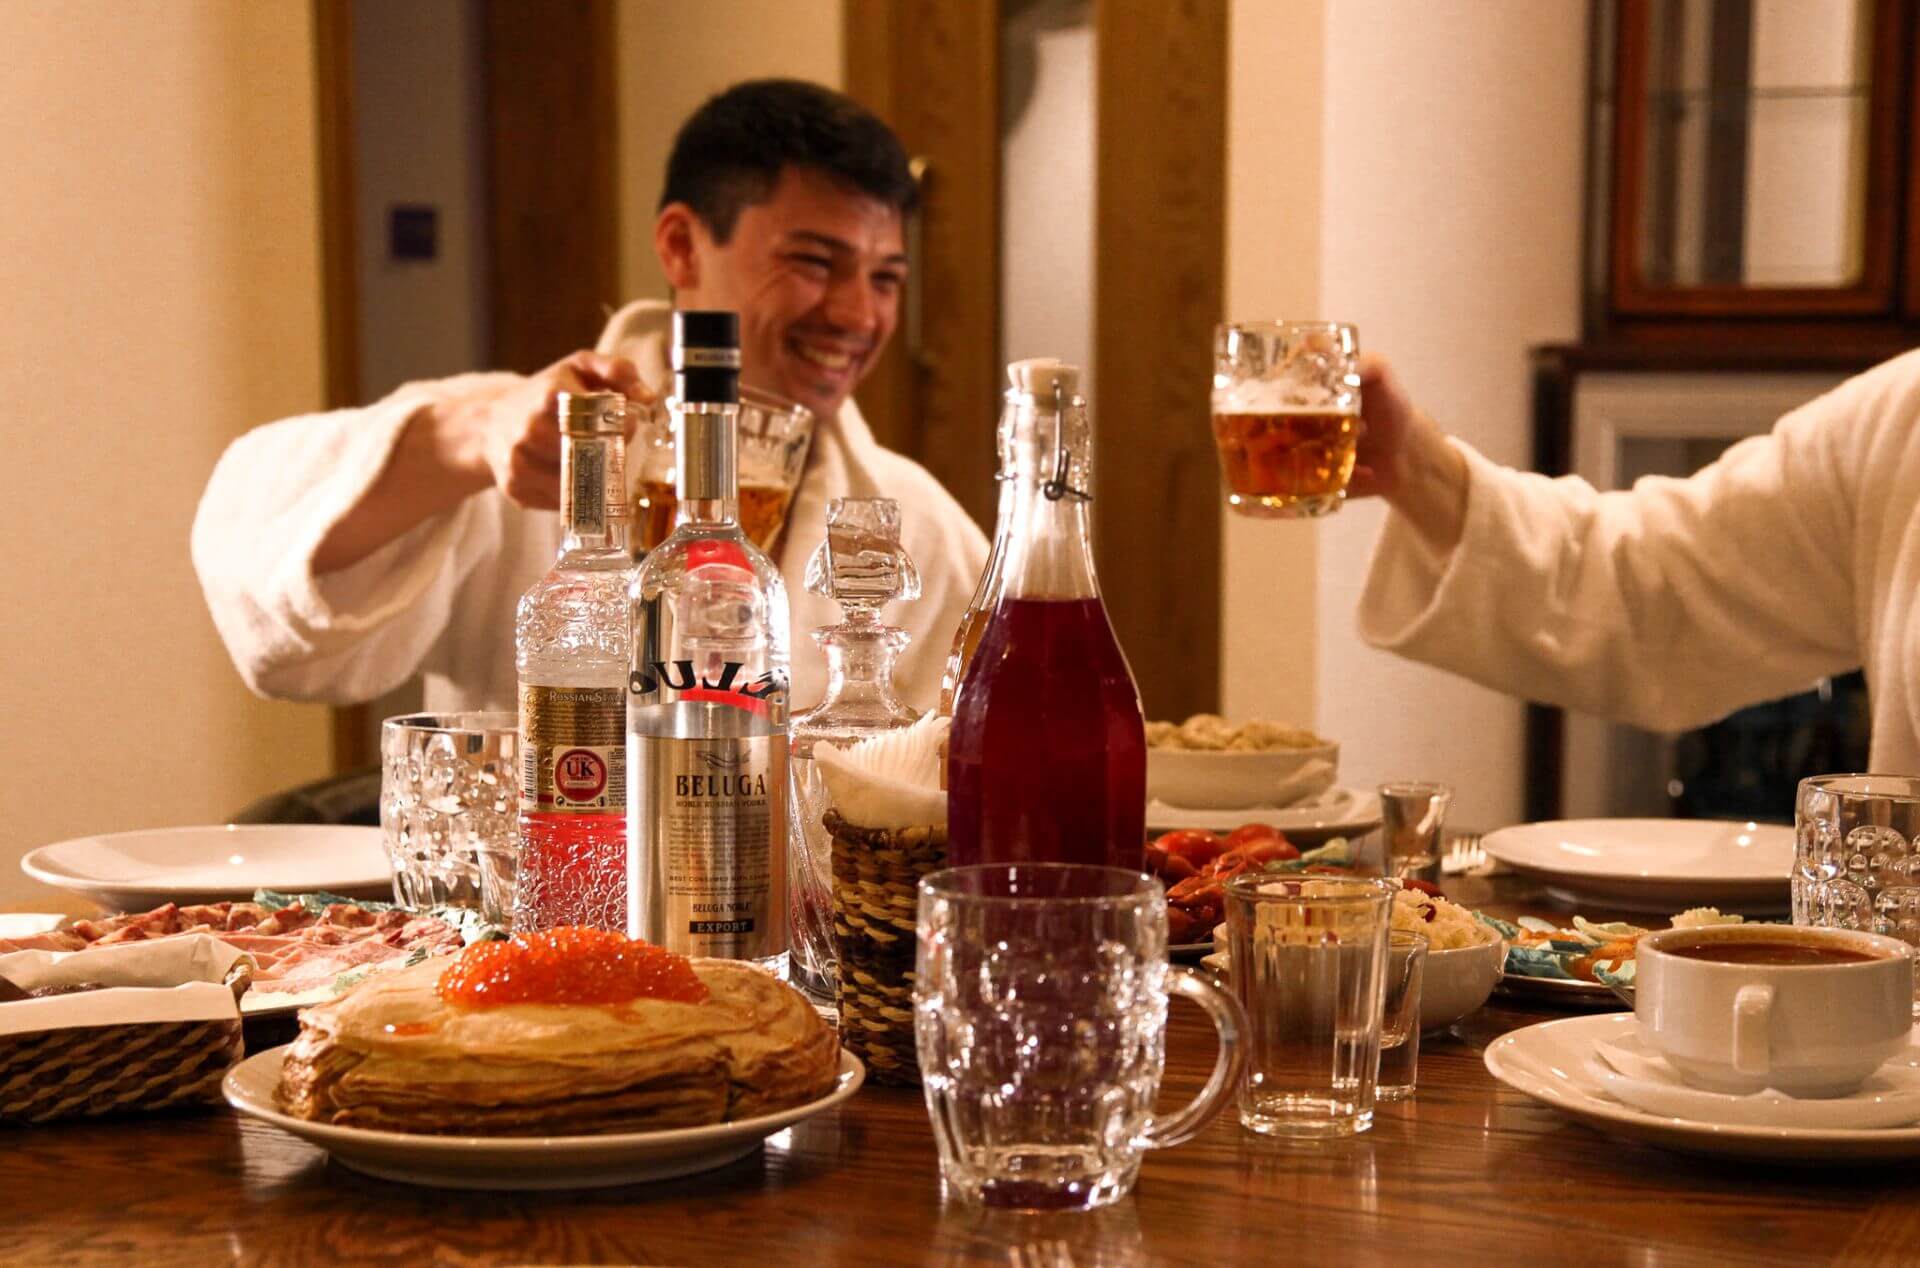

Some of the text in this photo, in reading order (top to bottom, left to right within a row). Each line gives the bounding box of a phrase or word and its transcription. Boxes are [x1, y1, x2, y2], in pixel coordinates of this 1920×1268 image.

[566, 760, 595, 777] UK
[676, 774, 766, 796] BELUGA
[676, 800, 702, 808] NOBLE
[704, 800, 740, 808] RUSSIAN
[693, 903, 725, 912] BELUGA
[697, 922, 748, 932] EXPORT
